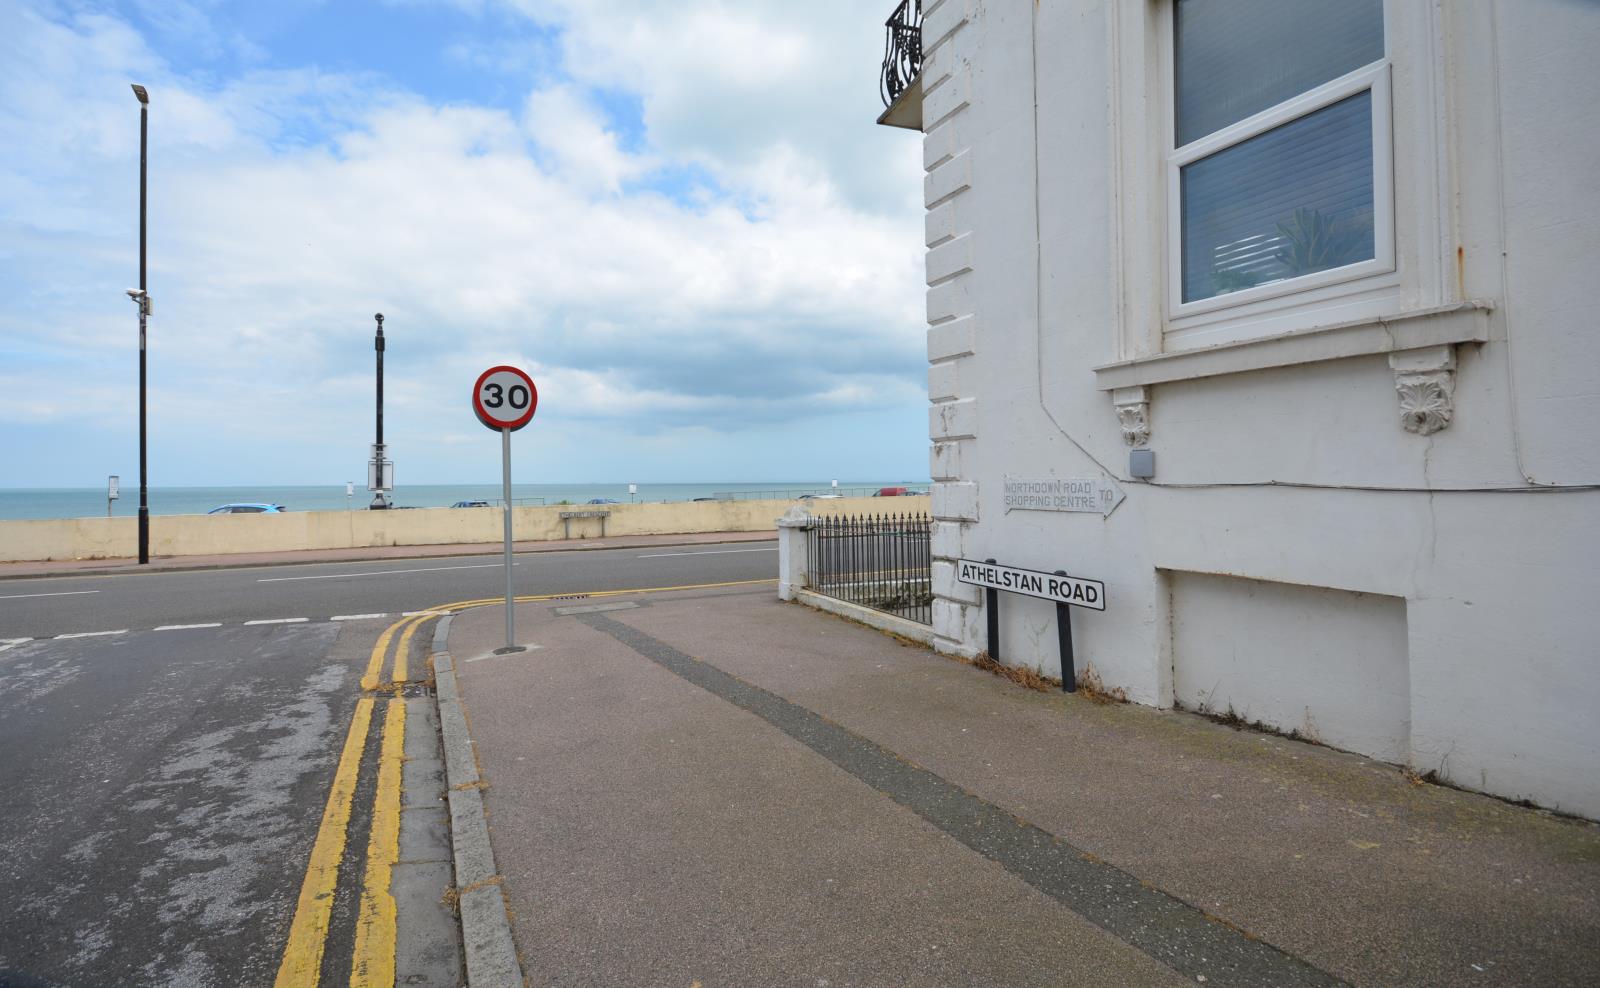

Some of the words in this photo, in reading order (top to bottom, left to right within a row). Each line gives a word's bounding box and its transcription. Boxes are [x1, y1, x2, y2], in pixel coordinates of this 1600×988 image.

[484, 383, 528, 409] 30
[1005, 482, 1061, 494] NORTHDOWN
[1063, 482, 1091, 494] ROAD
[1005, 495, 1050, 506] SHOPPING
[1053, 496, 1096, 508] CENTRE
[1098, 489, 1113, 501] TO
[962, 564, 1042, 593] ATHELSTAN
[1049, 578, 1098, 603] ROAD
